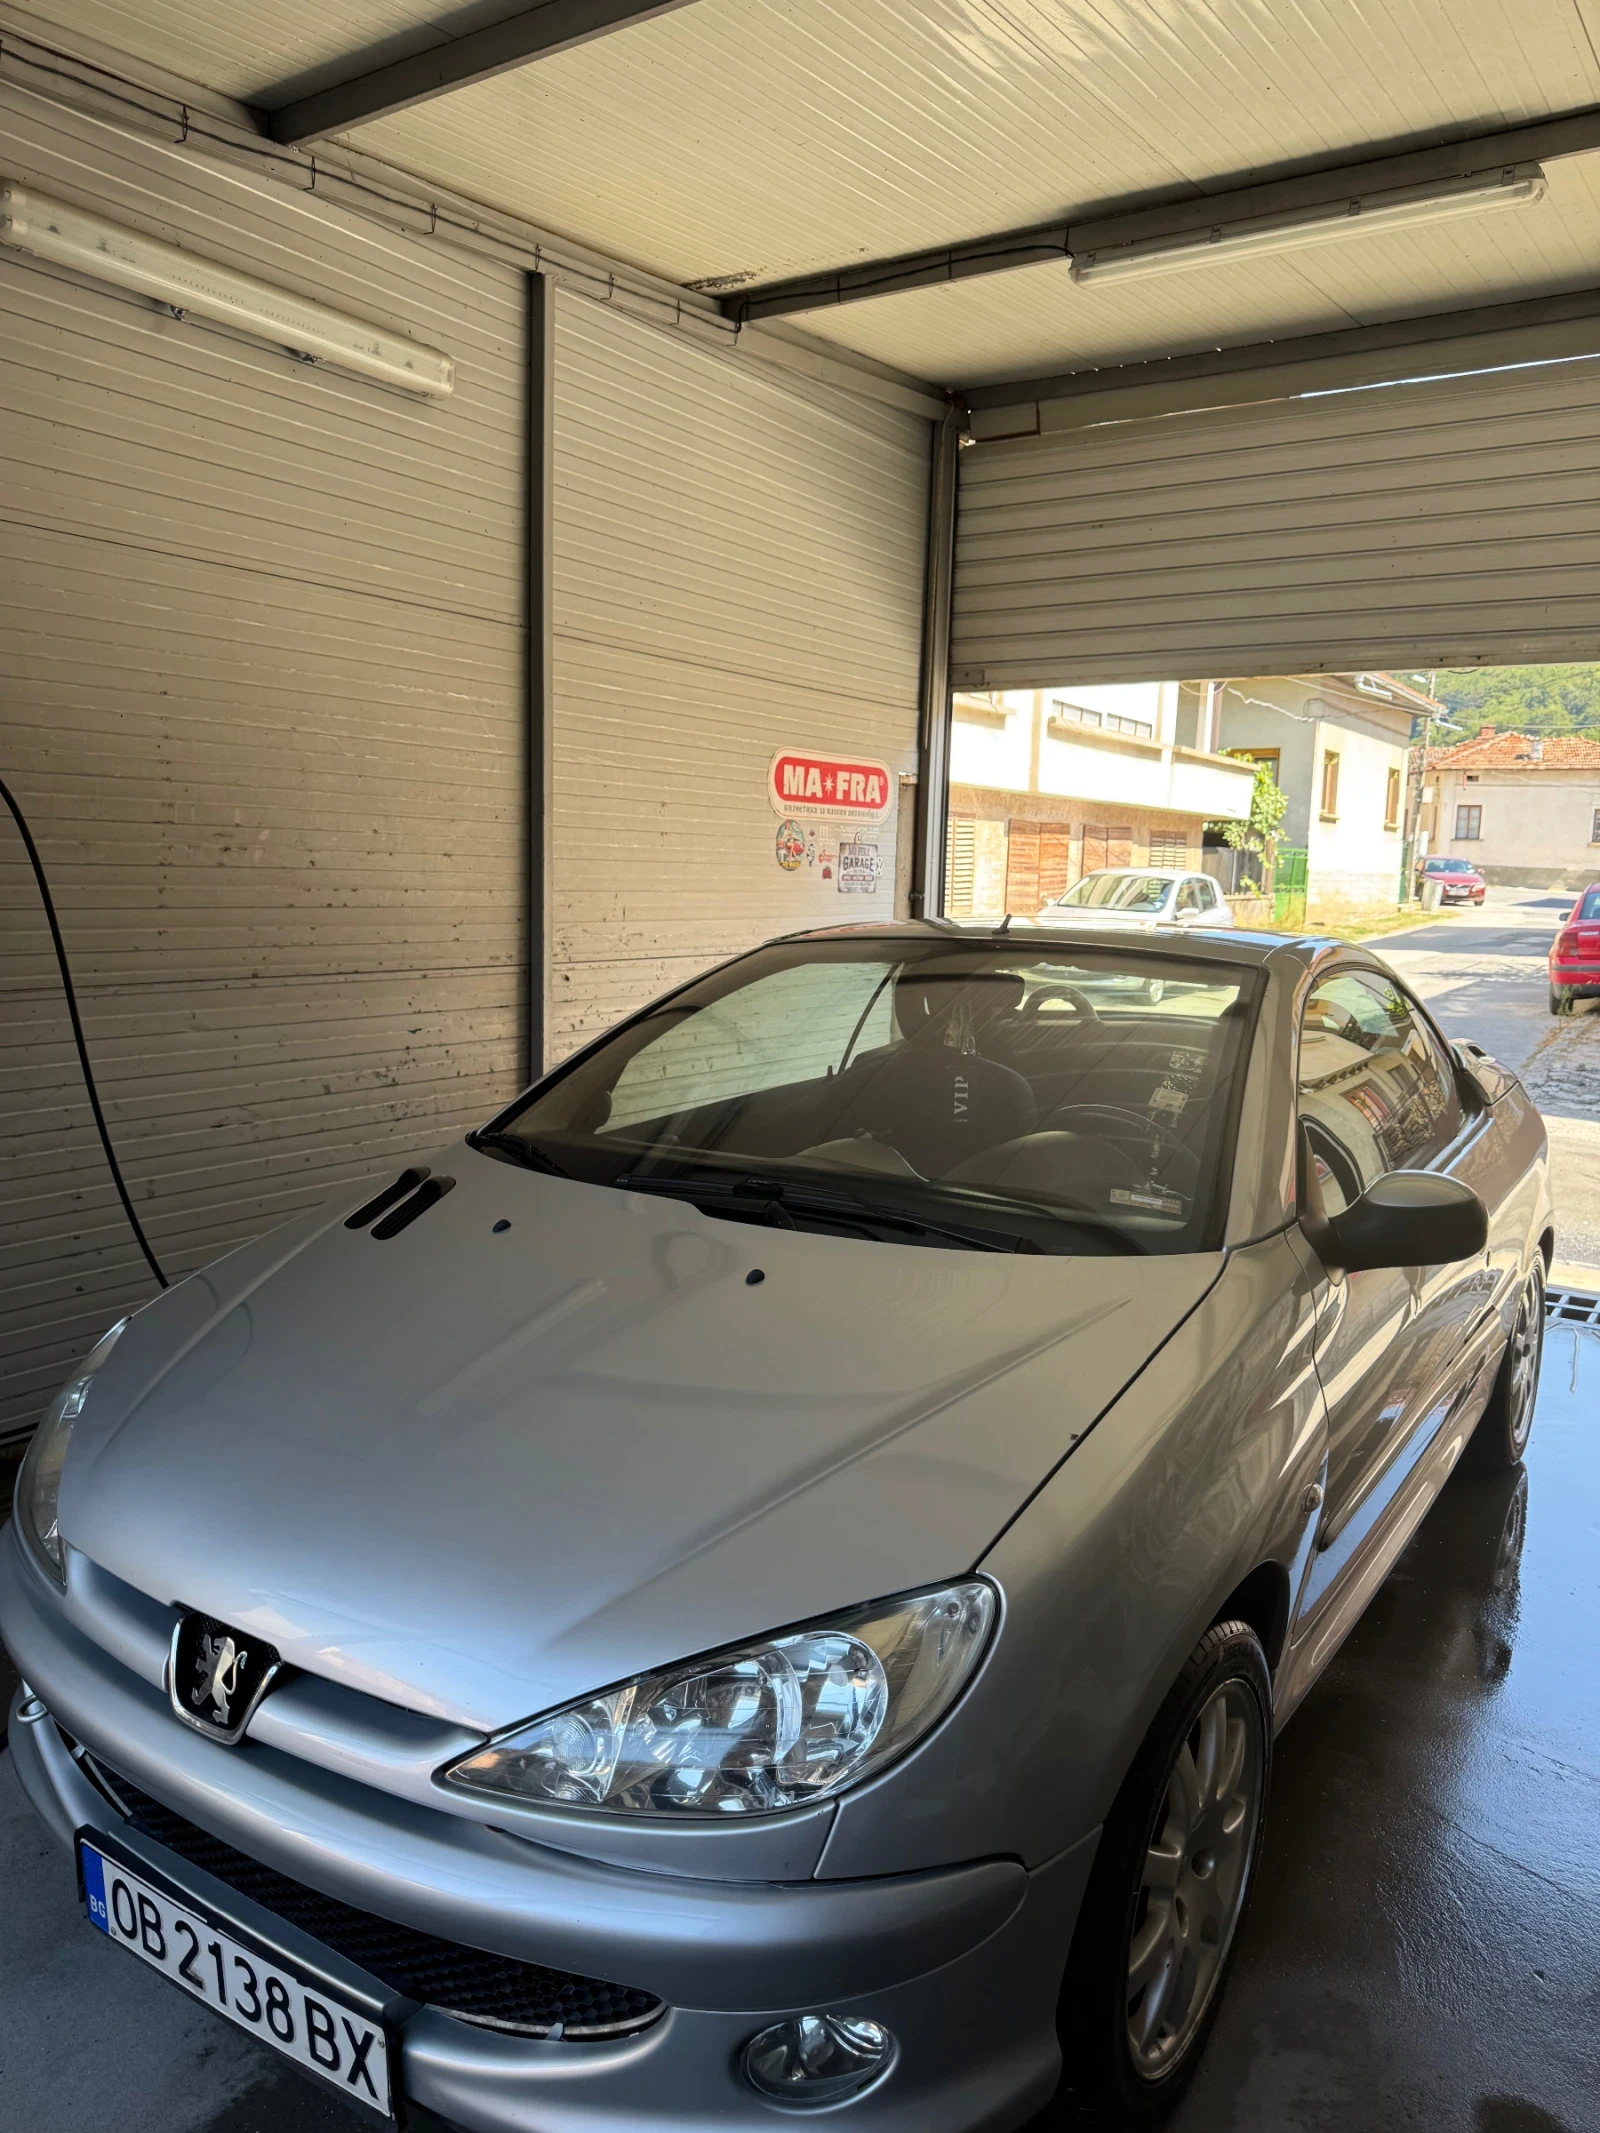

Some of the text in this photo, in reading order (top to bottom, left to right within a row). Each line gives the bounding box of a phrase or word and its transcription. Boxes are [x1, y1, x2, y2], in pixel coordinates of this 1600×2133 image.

[843, 856, 875, 872] GARAGE
[953, 1075, 969, 1116] VIP
[89, 1893, 106, 1919] BG
